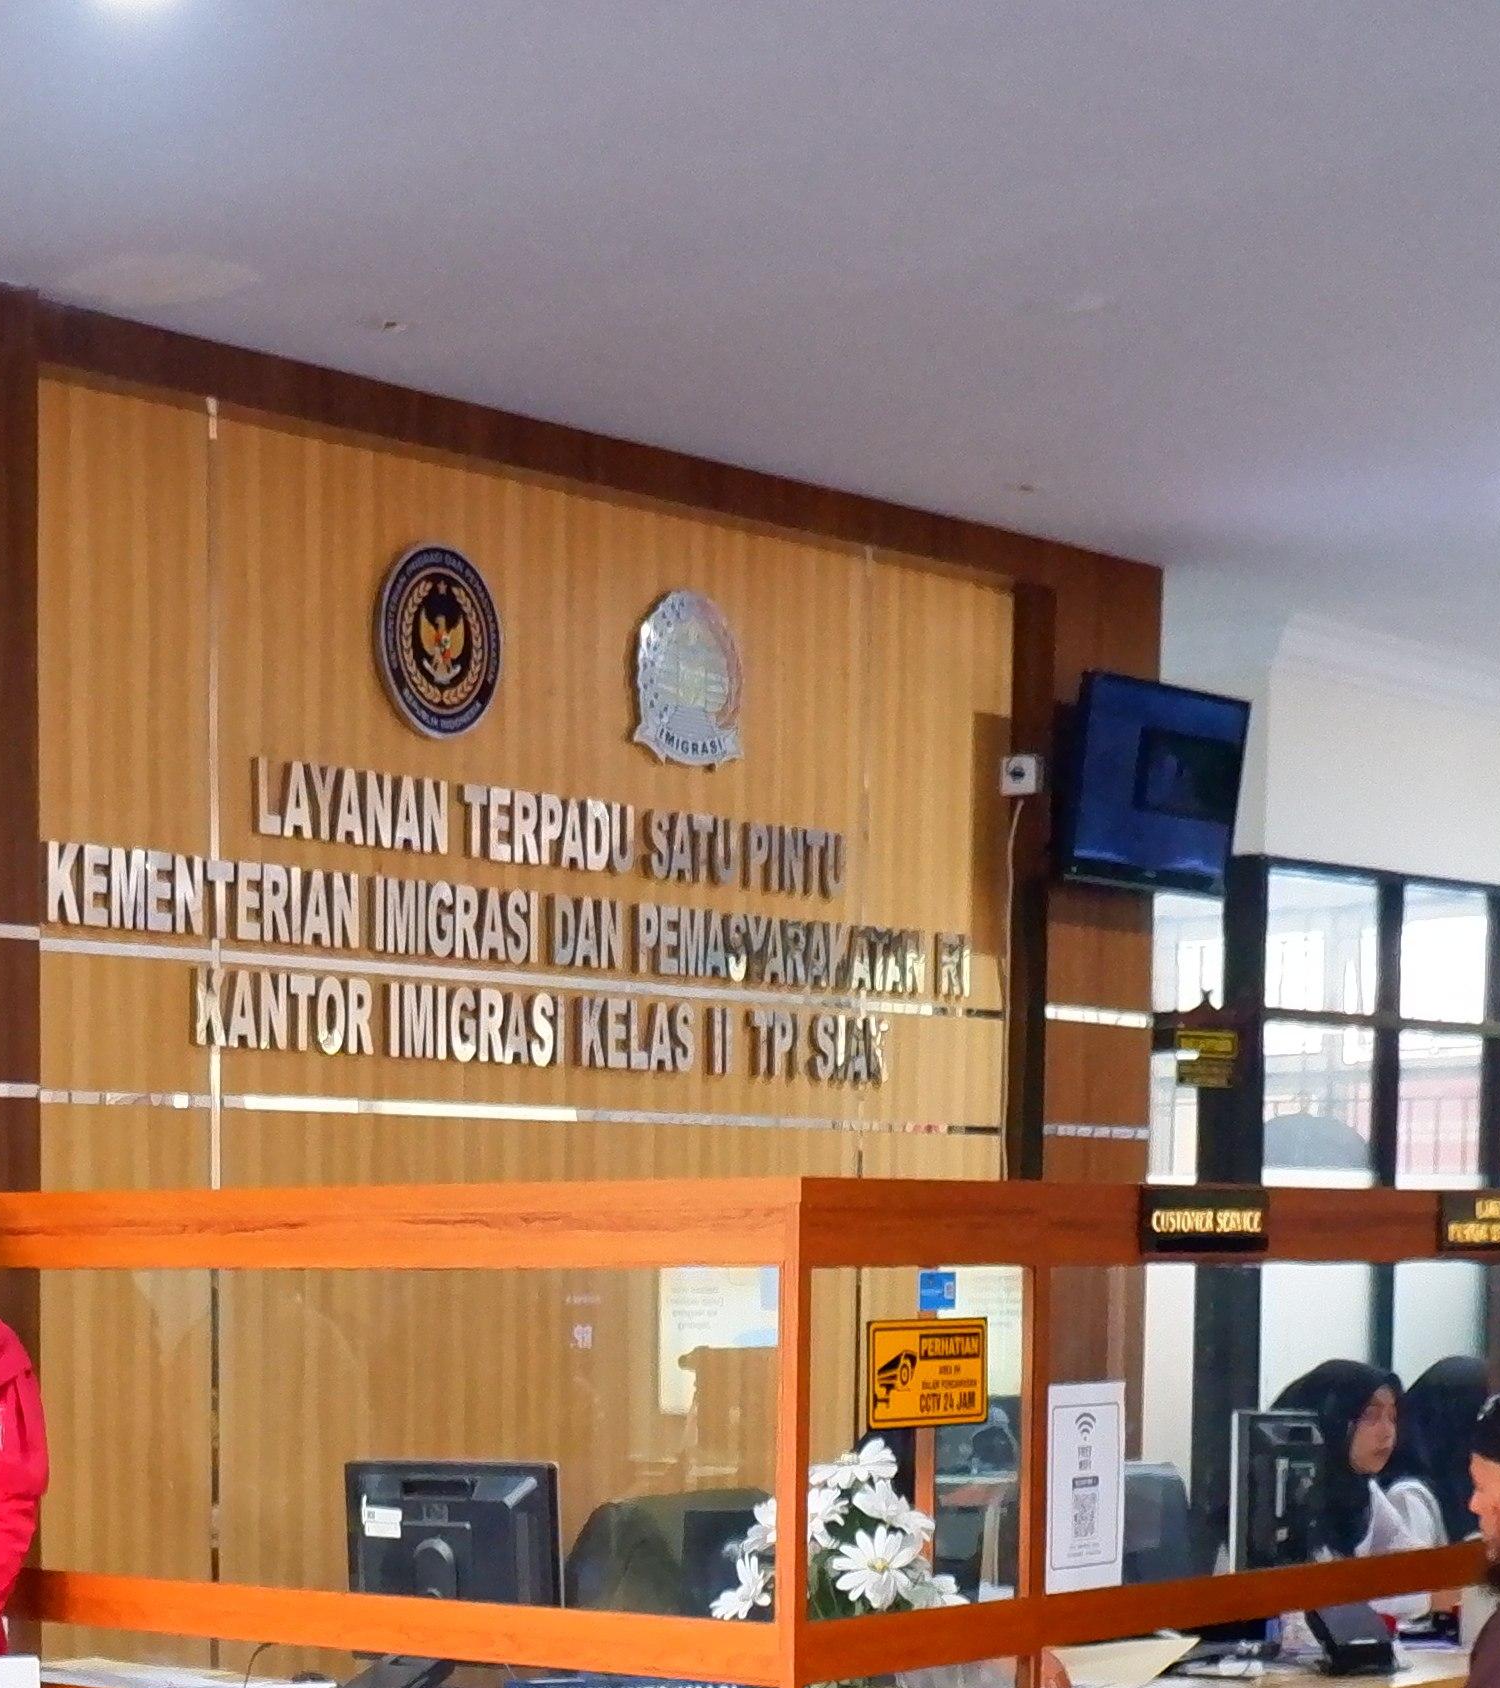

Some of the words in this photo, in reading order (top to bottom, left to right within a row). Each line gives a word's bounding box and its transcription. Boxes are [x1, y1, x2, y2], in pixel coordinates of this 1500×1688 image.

[658, 727, 725, 756] IMIGRASI
[255, 755, 450, 856] LAYANAN
[463, 784, 636, 873] TERPADU
[650, 806, 737, 886] SATU
[747, 822, 848, 899] PINTU
[46, 839, 361, 950] KEMENTERIAN
[374, 873, 540, 965] IMIGRASI
[553, 894, 624, 971] DAN
[638, 902, 927, 994] PEMASYARAKATAN
[937, 931, 972, 999] RI
[196, 969, 375, 1056] KANTOR
[387, 980, 567, 1068] IMIGRASI
[580, 996, 695, 1073] KELAS
[709, 1004, 734, 1077] II
[813, 1012, 890, 1086] SIAK
[1151, 1209, 1214, 1233] CUSTOMER
[1215, 1209, 1263, 1233] SERVICE
[921, 1336, 980, 1358] PERHATIAN
[919, 1392, 942, 1413] CCTV
[943, 1391, 955, 1411] 24
[957, 1390, 976, 1410] JAM
